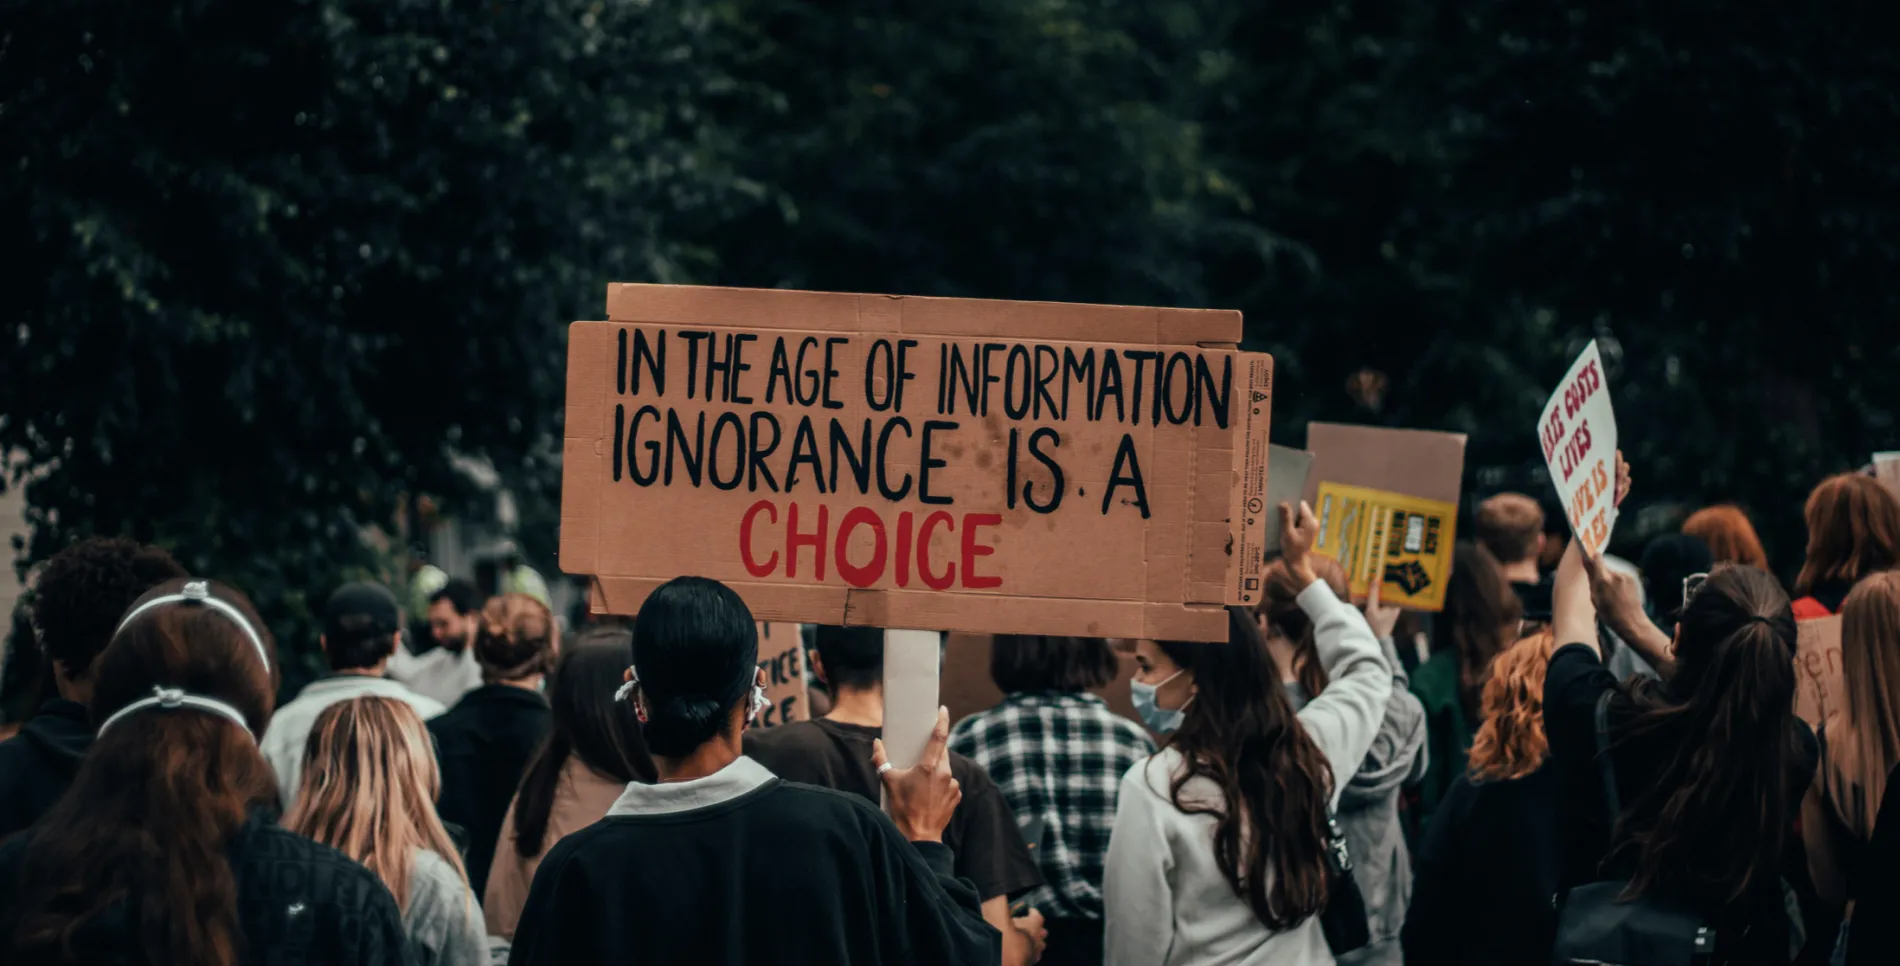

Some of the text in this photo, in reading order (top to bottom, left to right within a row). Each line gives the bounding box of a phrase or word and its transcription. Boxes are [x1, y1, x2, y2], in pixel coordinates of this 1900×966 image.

[617, 328, 666, 397] IN
[677, 331, 758, 404] THE
[765, 336, 849, 409] AGE
[865, 339, 918, 413] OF
[937, 342, 1231, 429] INFORMATION
[1564, 359, 1599, 420] COSTS
[613, 403, 959, 504] IGNORANCE
[1101, 433, 1150, 519] A
[1560, 418, 1592, 484] LIVES
[1592, 458, 1608, 498] IS
[739, 500, 1003, 590] CHOICE
